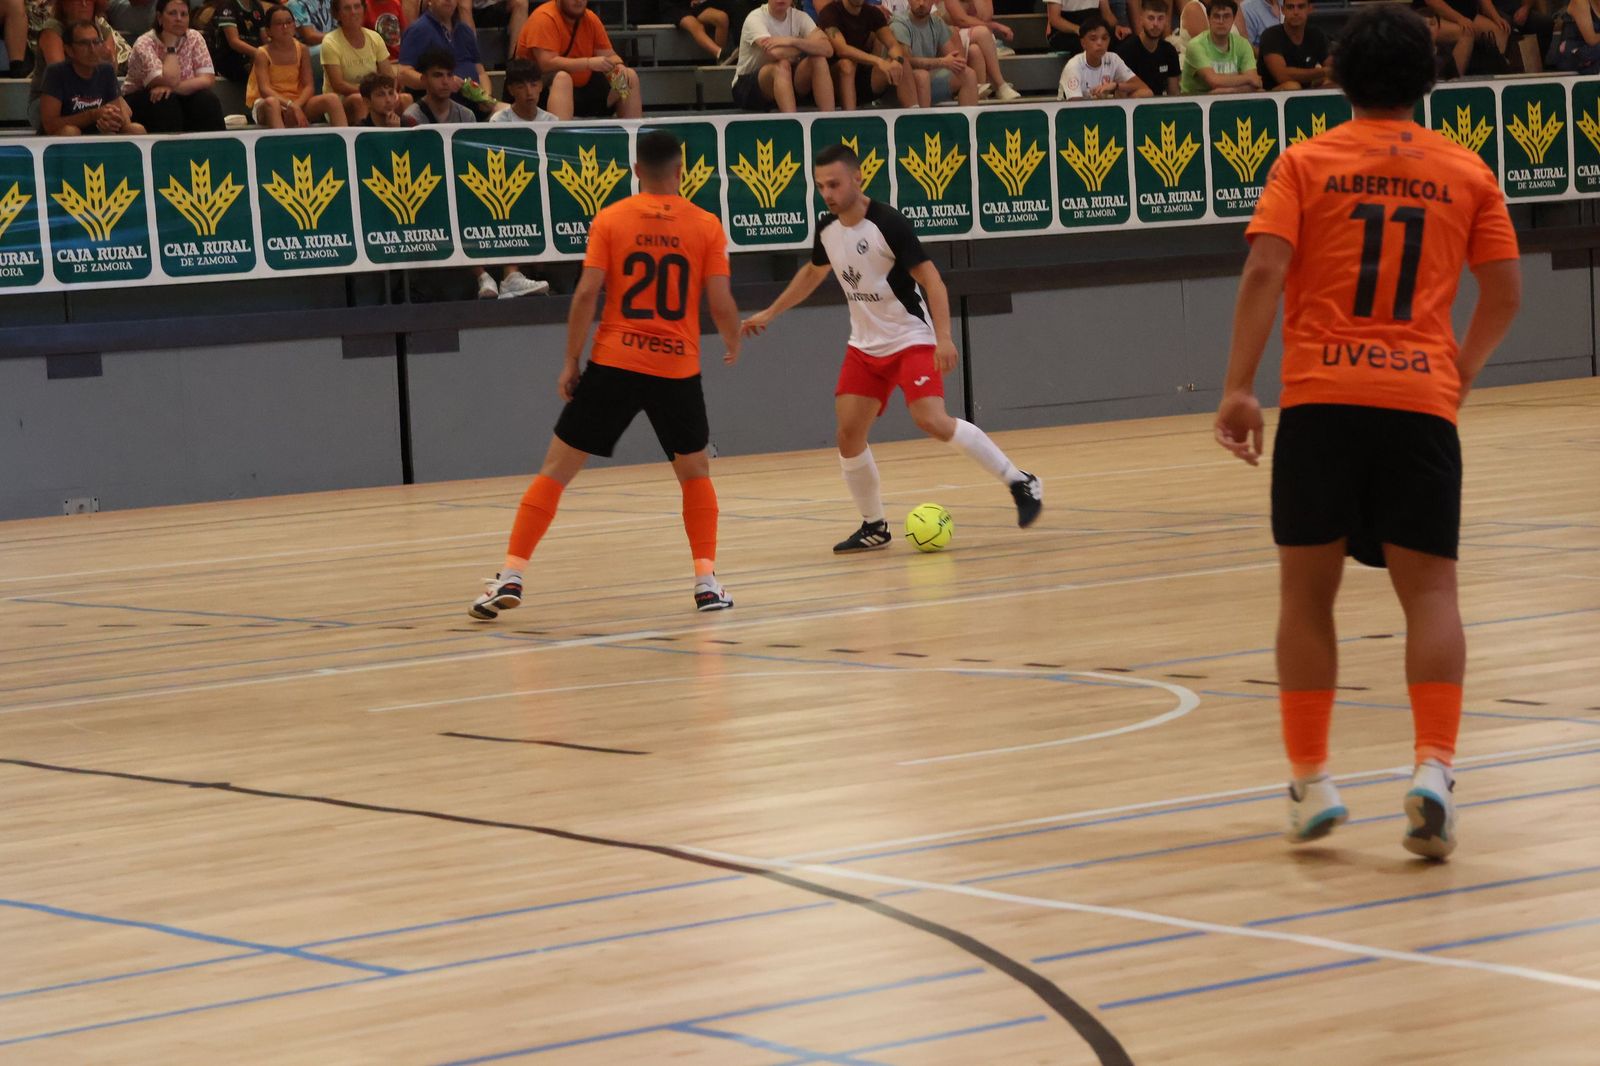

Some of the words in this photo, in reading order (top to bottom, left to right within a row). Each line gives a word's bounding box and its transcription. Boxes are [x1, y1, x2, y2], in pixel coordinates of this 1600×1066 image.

[1507, 168, 1532, 182] CAJA
[1533, 166, 1567, 180] RURAL
[1577, 165, 1600, 177] CAJA
[1517, 182, 1527, 190] DE
[1529, 180, 1556, 189] ZAMORA
[1587, 177, 1597, 185] DE
[1139, 193, 1166, 206] CAJA
[1168, 190, 1204, 203] RURAL
[1215, 187, 1242, 201] CAJA
[1243, 186, 1264, 199] RUR
[982, 201, 1010, 215] CAJA
[1012, 200, 1050, 213] RURAL
[1061, 198, 1089, 211] CAJA
[1091, 195, 1128, 208] RURAL
[1151, 206, 1162, 214] DE
[1163, 204, 1193, 213] ZAMORA
[1227, 201, 1237, 209] DE
[733, 213, 762, 227] CAJA
[764, 211, 805, 226] RURAL
[901, 206, 930, 219] CAJA
[931, 204, 970, 217] RURAL
[994, 215, 1006, 223] DE
[1007, 213, 1038, 223] ZAMORA
[1073, 211, 1084, 219] DE
[1086, 208, 1117, 218] ZAMORA
[555, 221, 588, 236] CAJA
[746, 228, 757, 236] DE
[760, 225, 793, 235] ZAMORA
[914, 220, 925, 228] DE
[926, 218, 959, 227] ZAMORA
[367, 231, 402, 245] CAJA
[403, 228, 449, 243] RURAL
[463, 226, 496, 240] CAJA
[498, 223, 541, 238] RURAL
[164, 242, 200, 257] CAJA
[202, 239, 251, 255] RURAL
[267, 236, 302, 251] CAJA
[304, 233, 352, 249] RURAL
[479, 241, 492, 249] DE
[494, 239, 530, 248] ZAMORA
[569, 236, 582, 245] DE
[636, 234, 680, 248] CHINO
[56, 247, 94, 263] CAJA
[96, 245, 147, 261] RURAL
[283, 252, 297, 260] DE
[300, 249, 339, 259] ZAMORA
[383, 246, 397, 254] DE
[399, 243, 437, 253] ZAMORA
[0, 251, 39, 266] URAL
[180, 257, 195, 267] DE
[197, 255, 238, 266] ZAMORA
[1348, 202, 1426, 322] 11
[73, 264, 88, 273] DE
[91, 261, 133, 272] ZAMORA
[621, 251, 690, 321] 20
[621, 332, 686, 356] uvesa
[1322, 343, 1431, 374] uvesa
